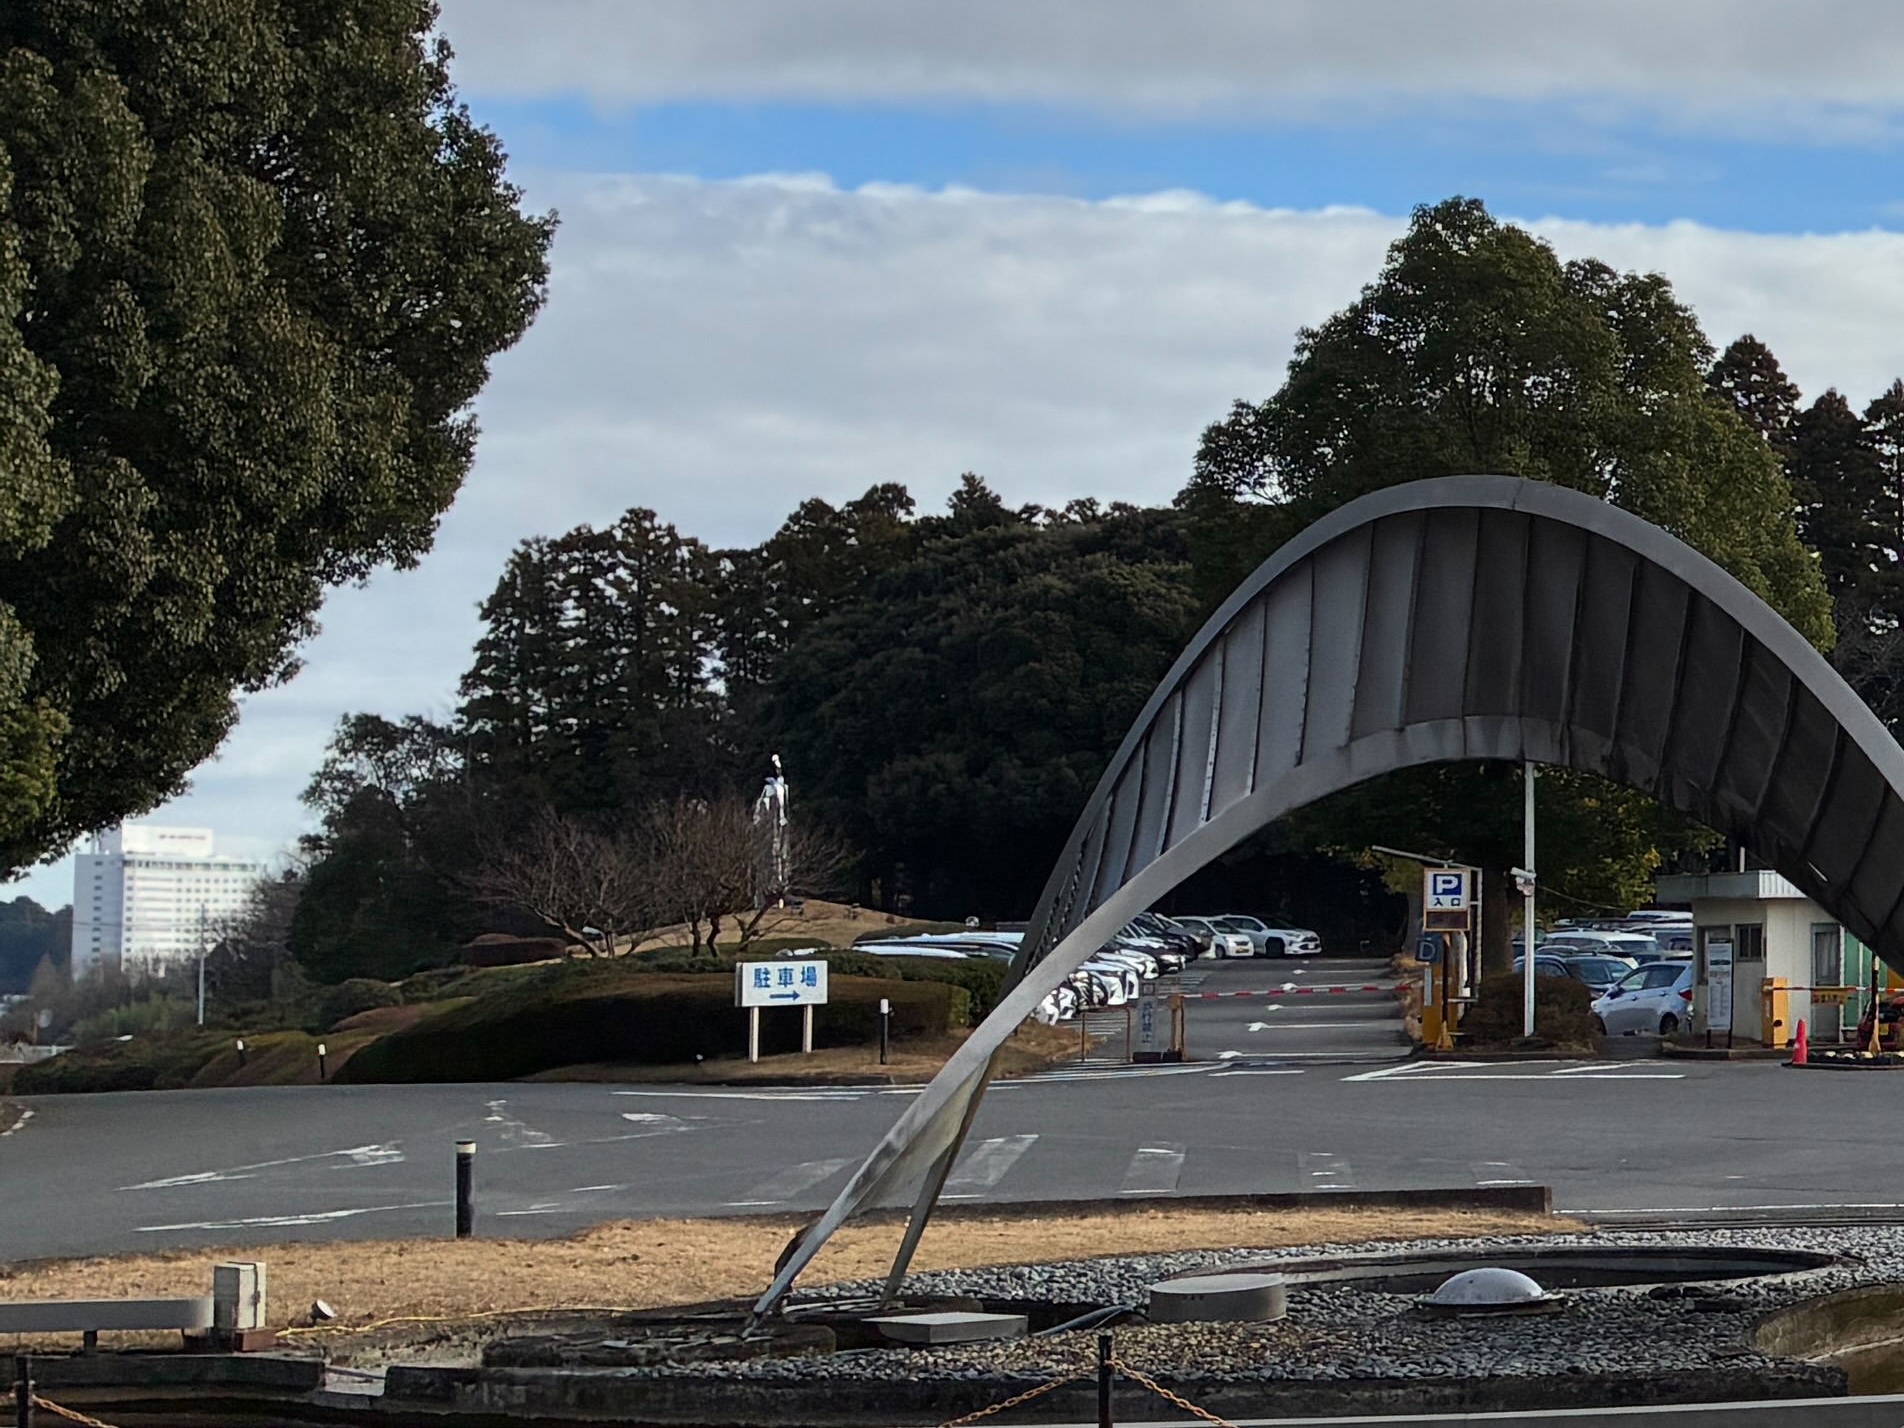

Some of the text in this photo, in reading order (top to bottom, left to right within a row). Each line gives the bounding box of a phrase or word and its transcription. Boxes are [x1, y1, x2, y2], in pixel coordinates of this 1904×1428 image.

[1436, 875, 1459, 894] P
[1434, 897, 1461, 907] 入口
[1419, 940, 1436, 960] D
[754, 965, 817, 988] 駐車場
